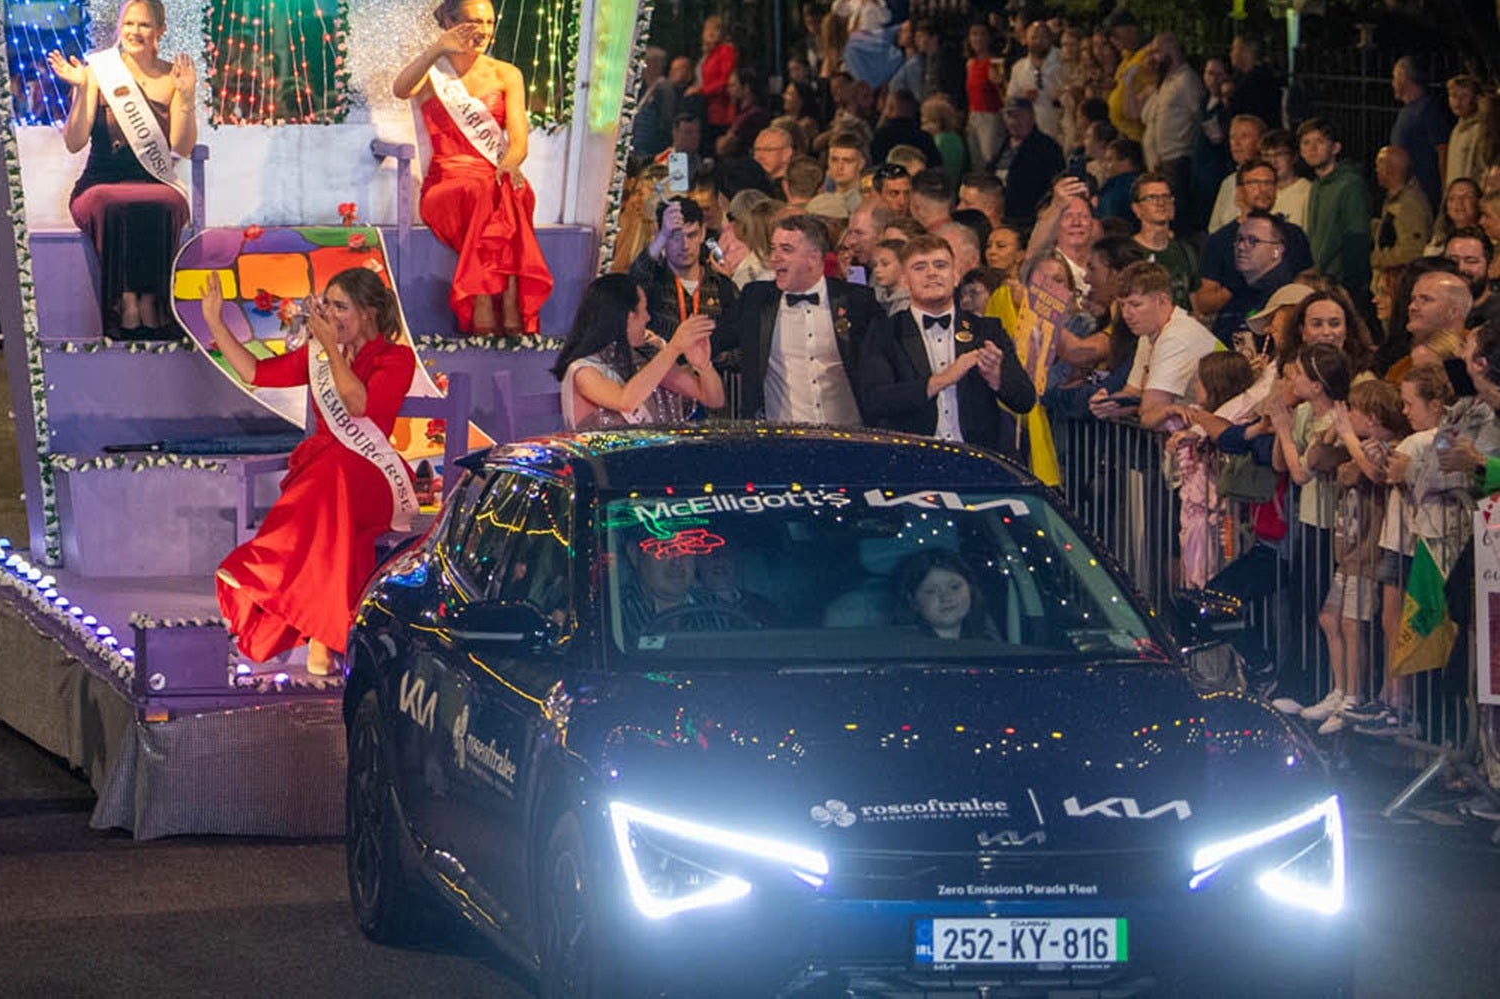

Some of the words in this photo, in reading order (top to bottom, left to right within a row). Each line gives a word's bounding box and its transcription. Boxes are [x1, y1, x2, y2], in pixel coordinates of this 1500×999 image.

[123, 101, 151, 140] OHIO
[143, 140, 169, 178] ROSE
[383, 463, 413, 512] ROSE
[633, 488, 851, 523] McElligott's
[860, 797, 1009, 816] roseoftralee
[937, 884, 965, 896] Zero
[966, 883, 1024, 895] Emissions
[1025, 883, 1067, 895] Parade
[1068, 883, 1098, 895] Fleet
[916, 944, 933, 956] IRL
[942, 927, 1109, 960] 252-KY-816
